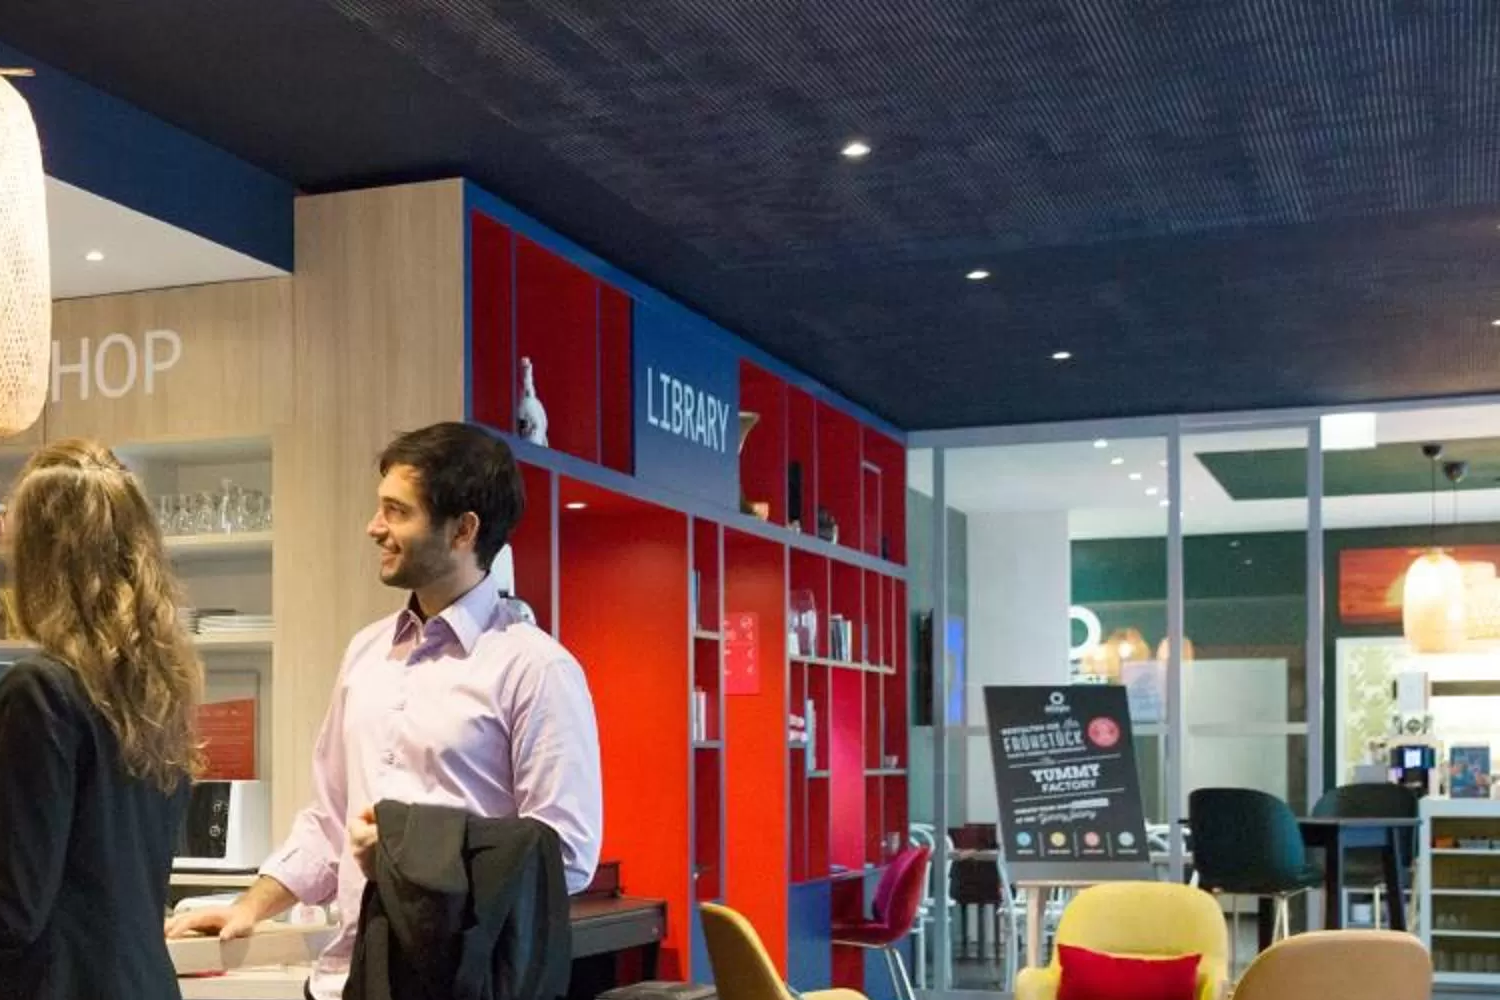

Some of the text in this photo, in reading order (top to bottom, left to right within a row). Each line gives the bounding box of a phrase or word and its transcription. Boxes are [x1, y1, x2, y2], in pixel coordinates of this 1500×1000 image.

[51, 329, 182, 403] HOP
[647, 366, 729, 453] LIBRARY
[1030, 763, 1100, 783] YUMMY
[1041, 779, 1097, 793] FACTORY
